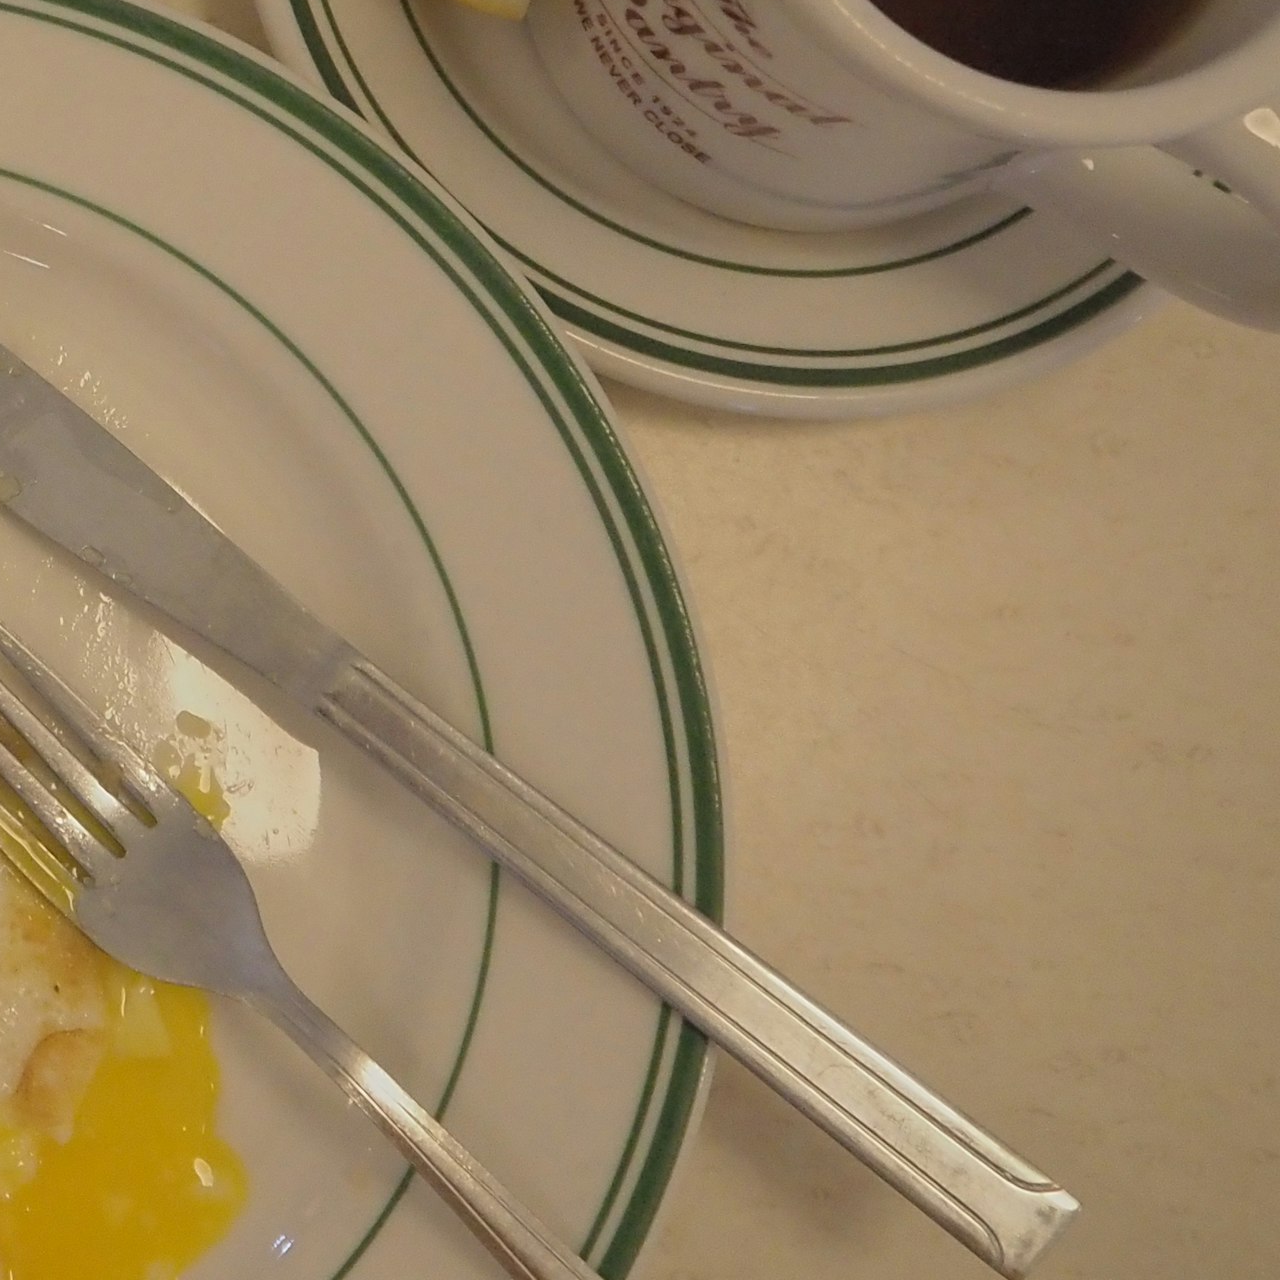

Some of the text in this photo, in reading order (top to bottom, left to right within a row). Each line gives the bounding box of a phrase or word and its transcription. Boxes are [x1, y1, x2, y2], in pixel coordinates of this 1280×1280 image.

[591, 36, 642, 106] NEVER
[644, 110, 711, 164] CLOSE
[596, 13, 697, 137] SINCE 1924
